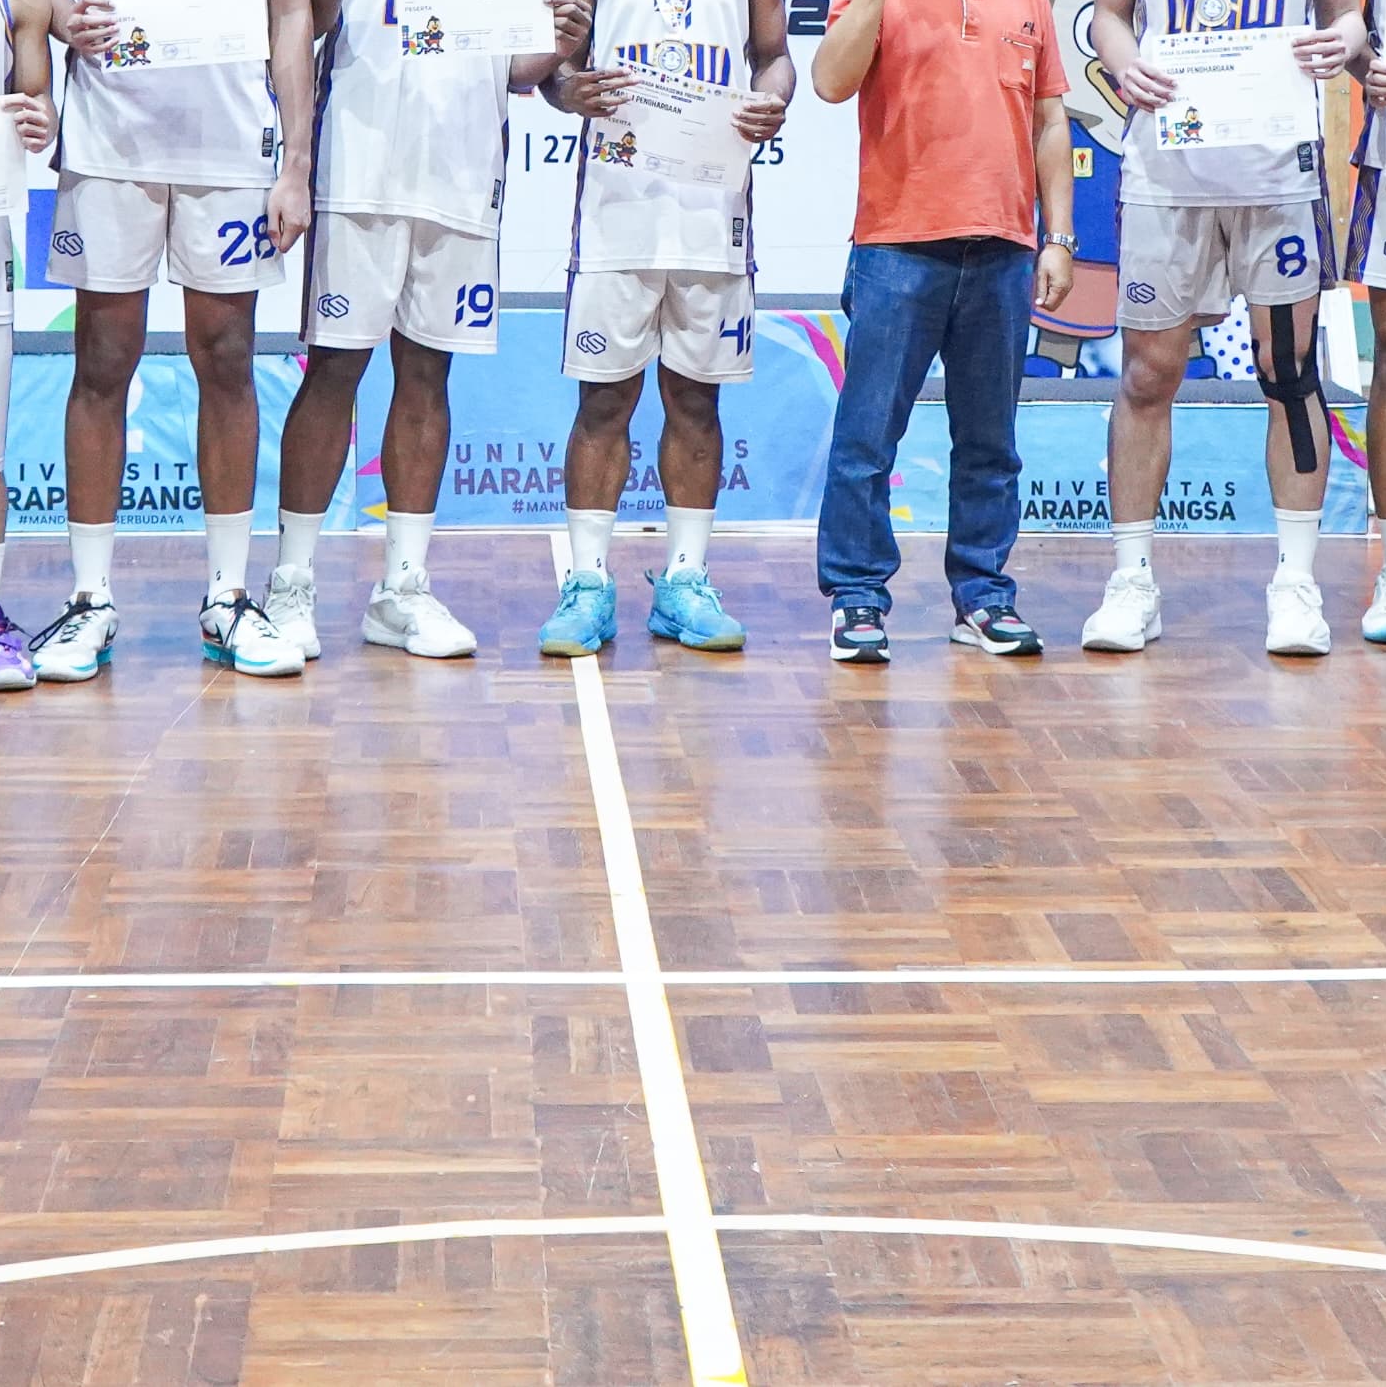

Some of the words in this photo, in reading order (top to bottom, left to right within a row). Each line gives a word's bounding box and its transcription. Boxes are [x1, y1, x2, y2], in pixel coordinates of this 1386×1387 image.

[542, 135, 579, 163] 27
[752, 137, 785, 165] 25
[216, 214, 278, 268] 28
[1274, 234, 1308, 279] 8
[454, 282, 495, 328] 19
[453, 466, 566, 495] HARAP
[1030, 480, 1236, 497] NIVEITAS
[120, 486, 203, 511] BANG
[18, 514, 66, 525] #MAND
[1154, 521, 1189, 531] UDAYA
